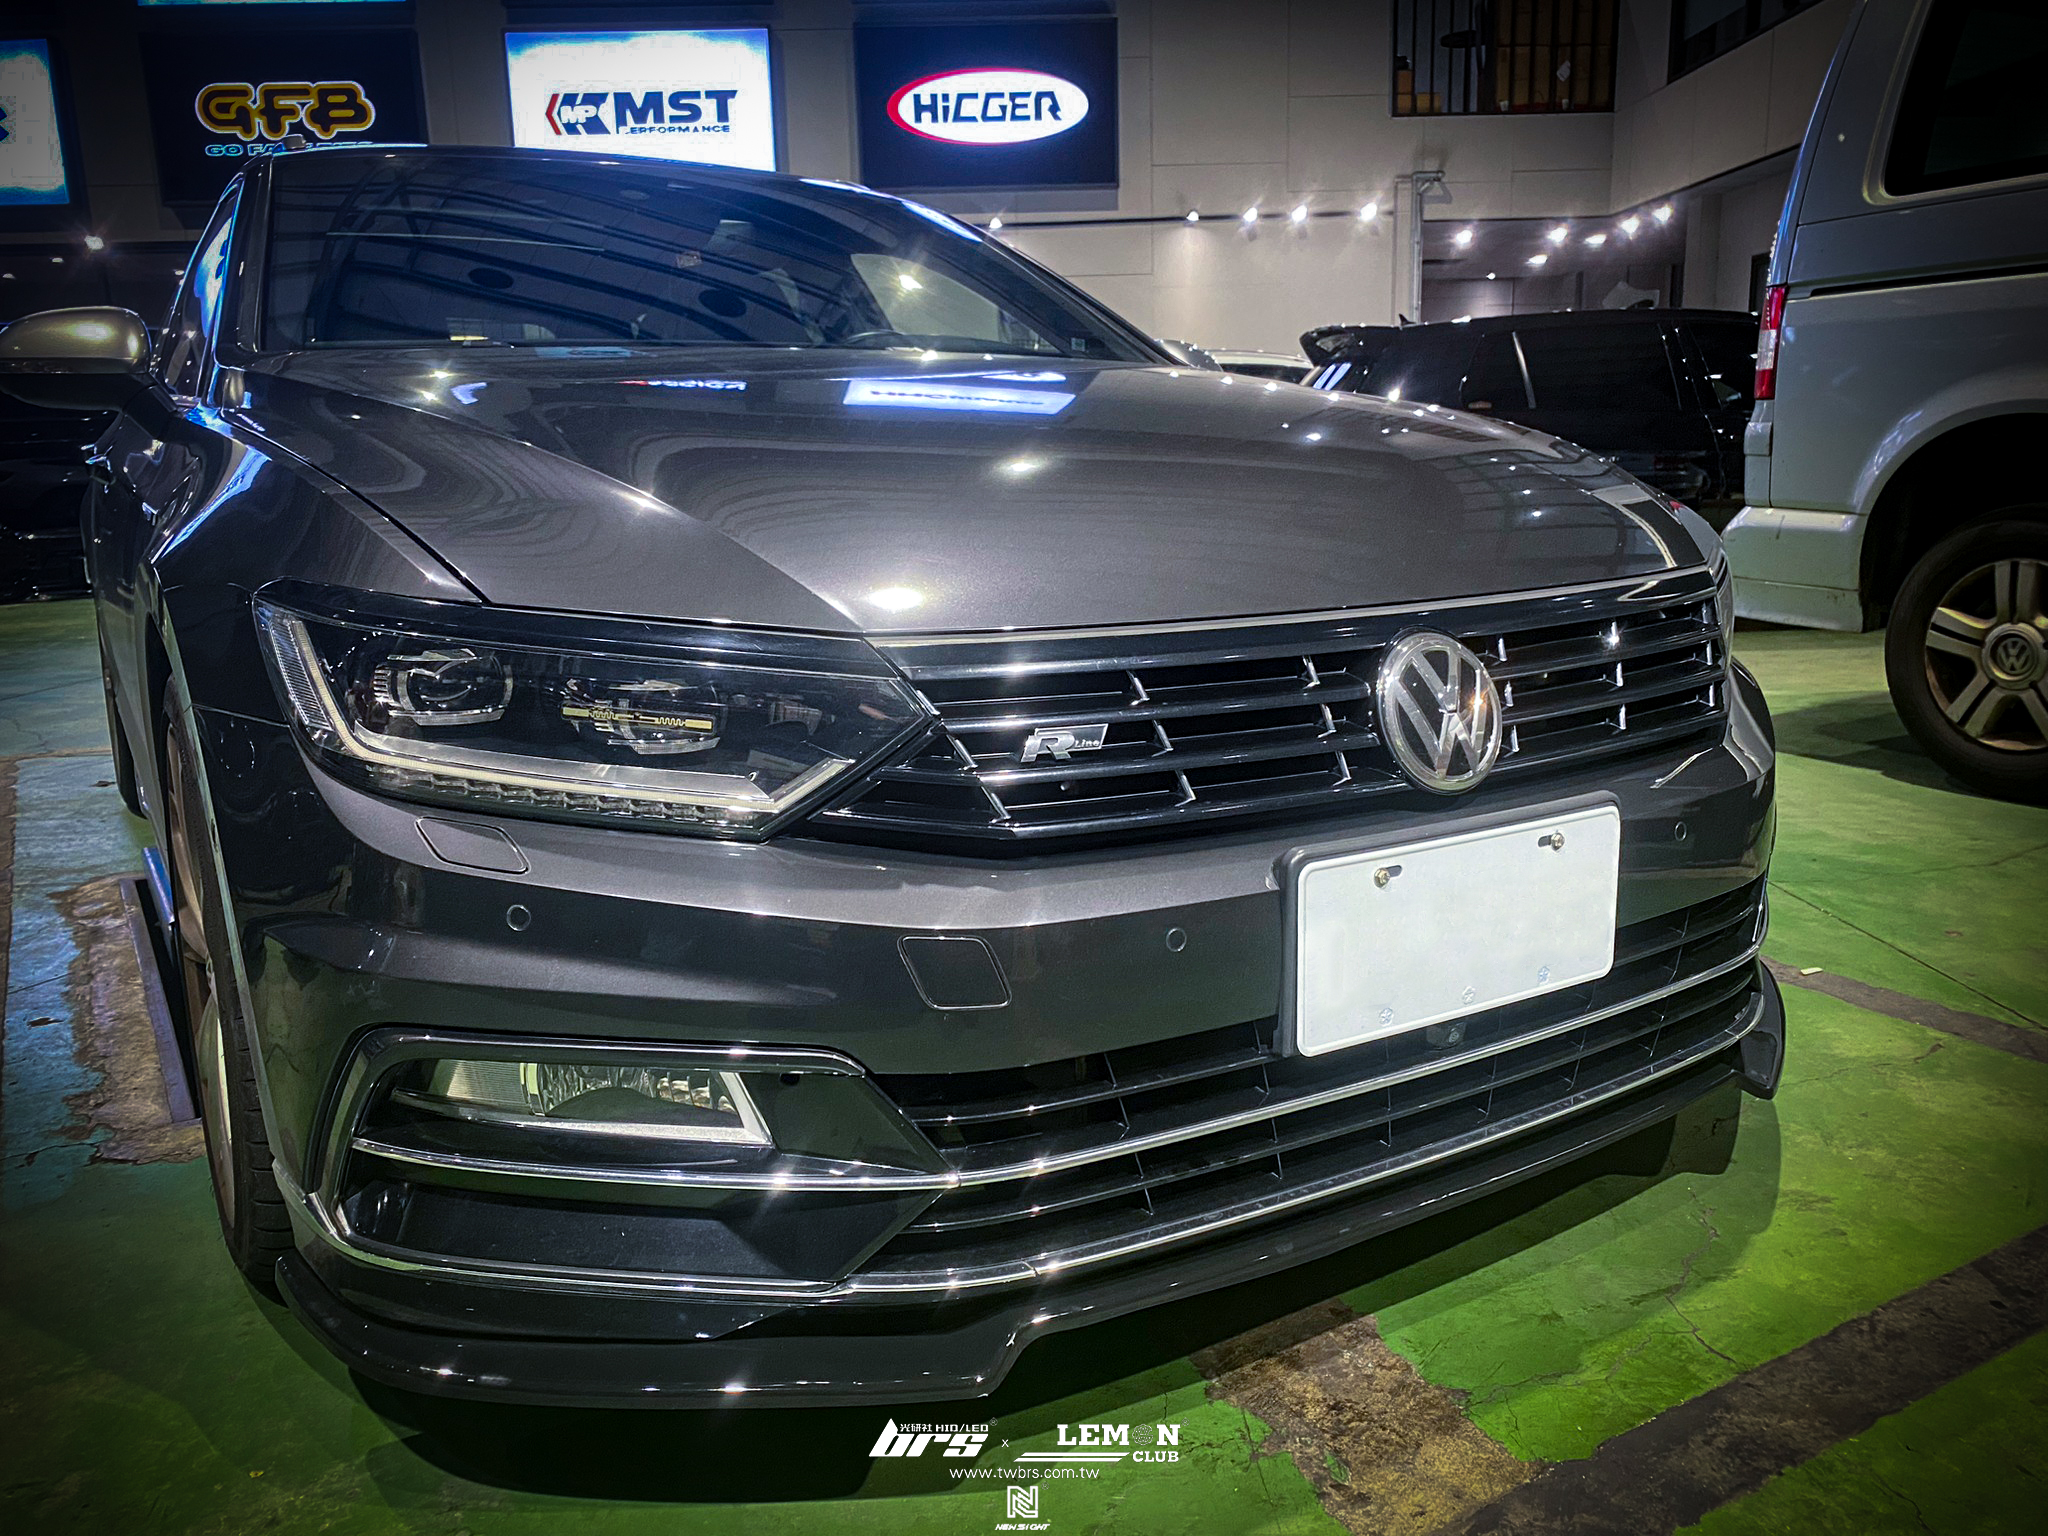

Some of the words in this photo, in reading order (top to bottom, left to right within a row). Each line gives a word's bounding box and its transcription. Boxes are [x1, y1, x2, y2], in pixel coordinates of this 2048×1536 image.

[195, 81, 376, 141] GFB
[613, 90, 739, 127] MST
[205, 144, 244, 157] GO
